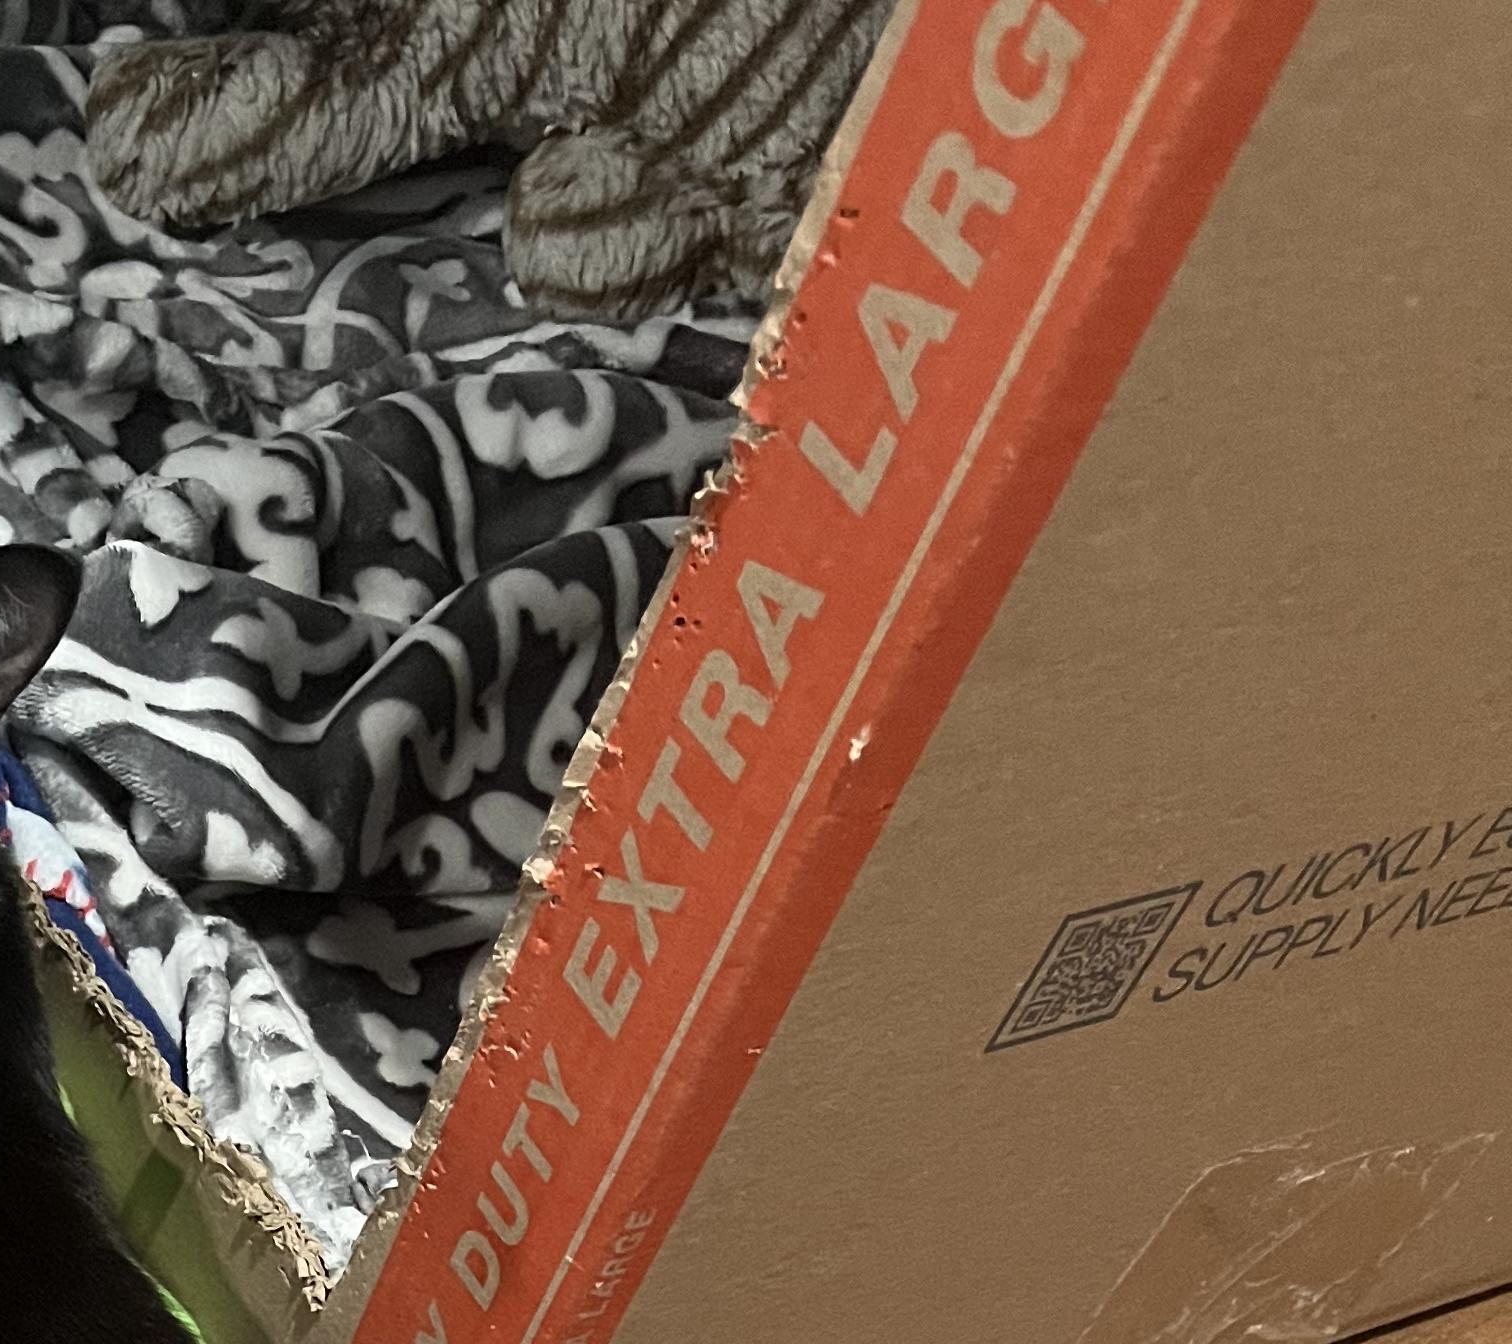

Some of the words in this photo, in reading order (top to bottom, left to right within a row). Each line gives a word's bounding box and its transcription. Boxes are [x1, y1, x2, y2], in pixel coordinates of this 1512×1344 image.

[450, 1041, 580, 1313] DUTY
[563, 558, 825, 1040] EXTRA
[797, 0, 1104, 518] LARG
[1205, 813, 1487, 928] QUICKLY
[1151, 893, 1405, 1003] SUPPLY
[578, 1207, 657, 1320] LARGE
